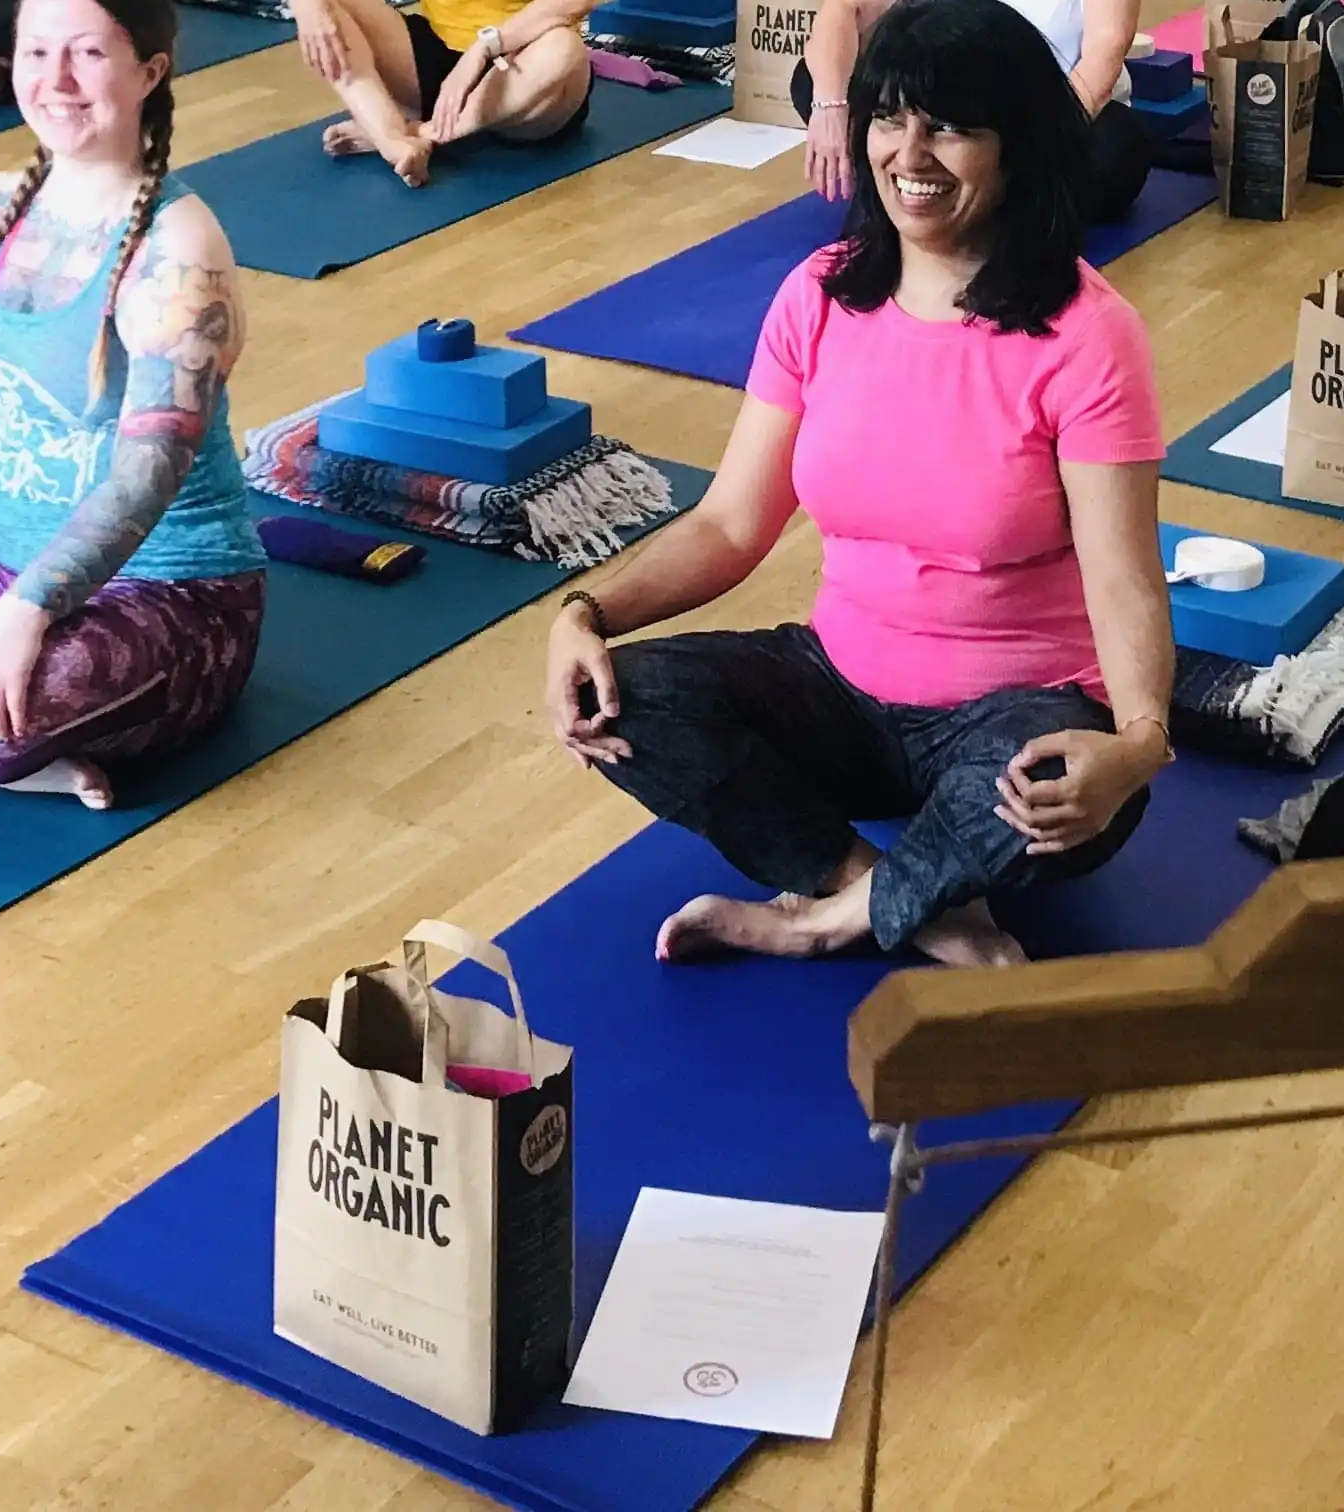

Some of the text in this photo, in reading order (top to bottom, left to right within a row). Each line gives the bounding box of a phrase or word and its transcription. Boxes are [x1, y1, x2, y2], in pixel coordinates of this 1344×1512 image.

[751, 28, 811, 57] ORGAN
[756, 4, 817, 33] PLANET
[318, 1085, 440, 1187] PLANET
[308, 1138, 452, 1248] ORGANIC
[312, 1288, 334, 1307] EAT
[369, 1316, 395, 1337] LIVE
[397, 1328, 439, 1357] BETTER
